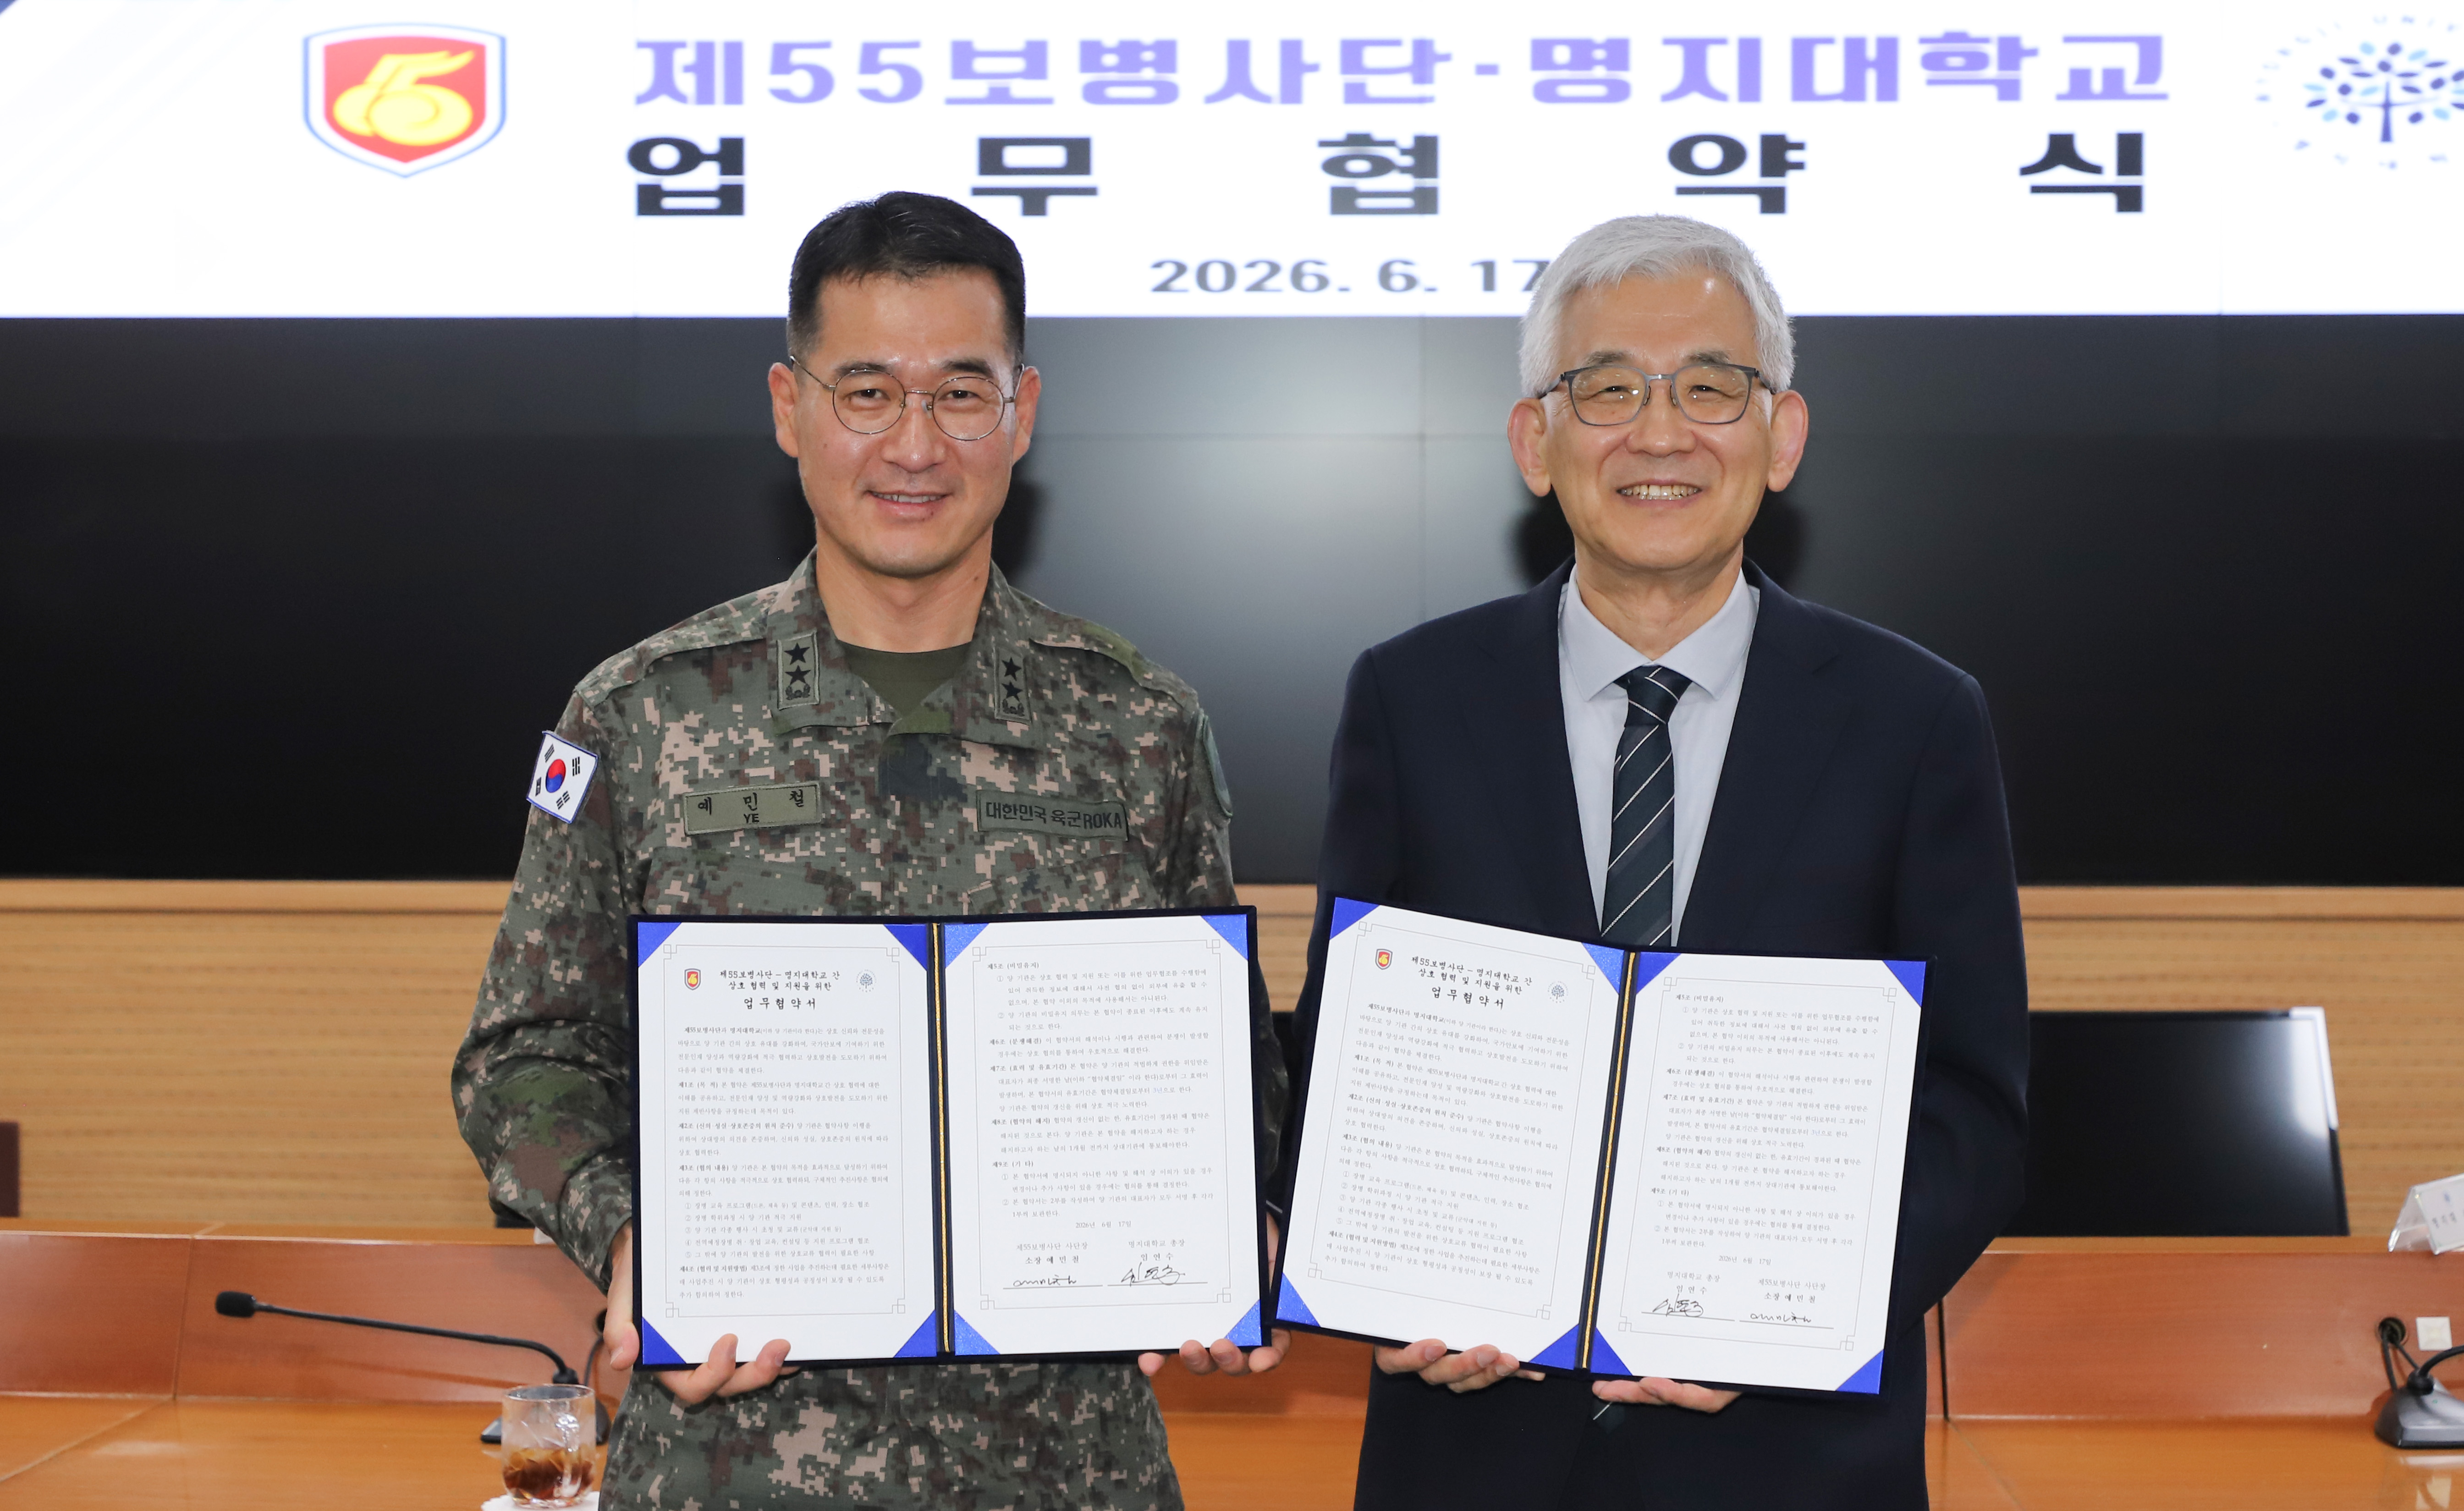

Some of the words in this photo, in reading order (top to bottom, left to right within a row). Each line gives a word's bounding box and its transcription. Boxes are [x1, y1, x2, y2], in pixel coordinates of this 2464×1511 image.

[1150, 259, 1351, 293] 2026.
[1376, 258, 1438, 293] 6.
[743, 813, 760, 824] YE
[986, 802, 1047, 824] 대한민국
[719, 969, 773, 979] 제55보병사단
[784, 970, 828, 979] 명지대학교
[831, 970, 841, 979] 간
